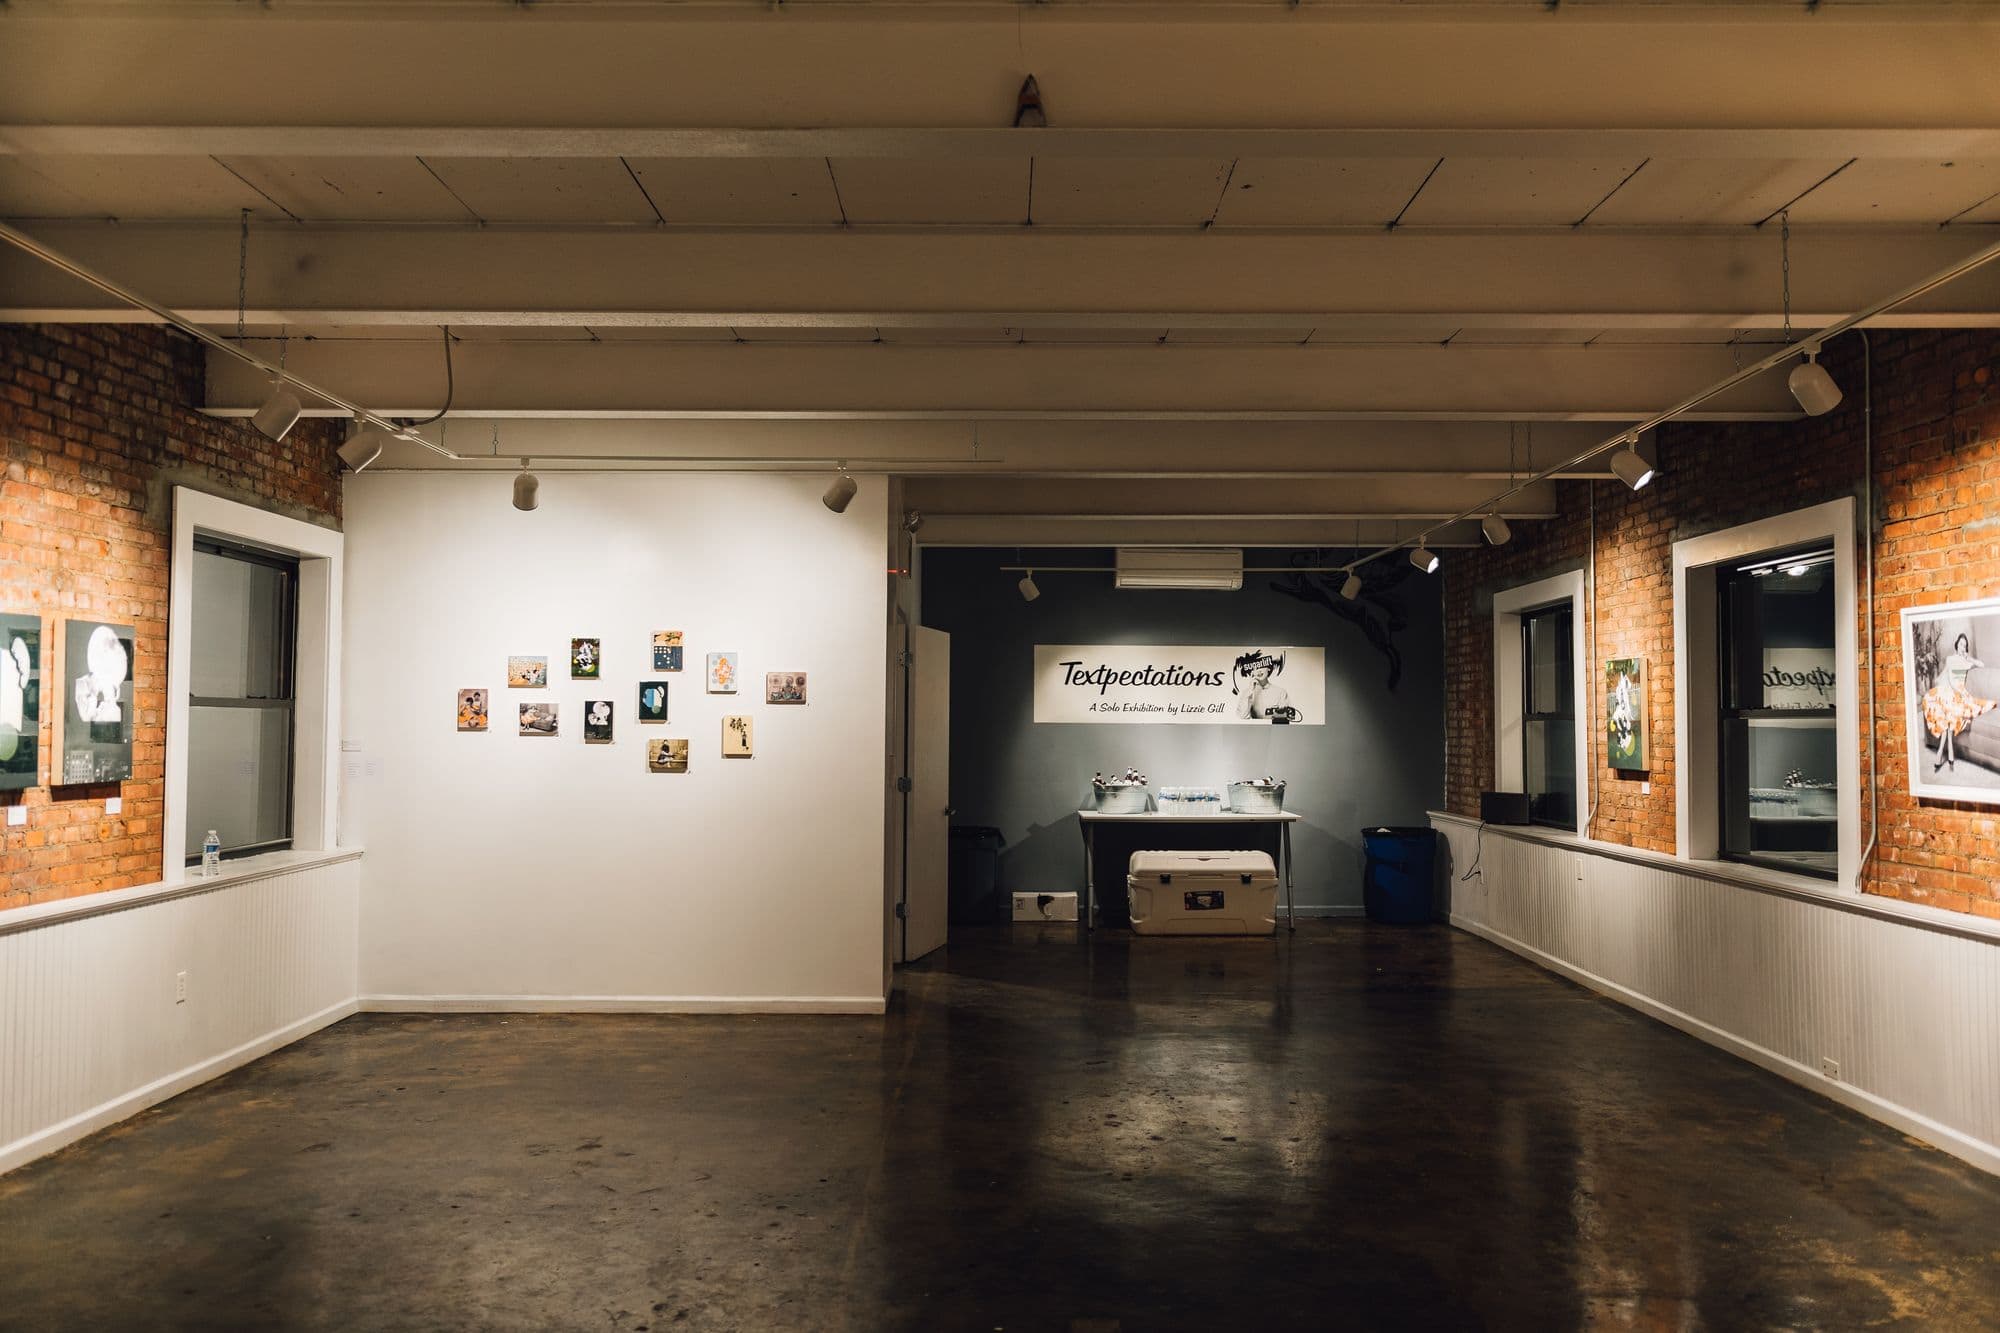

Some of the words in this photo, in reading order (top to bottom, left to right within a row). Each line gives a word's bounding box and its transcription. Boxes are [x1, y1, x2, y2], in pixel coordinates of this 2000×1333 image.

[1059, 661, 1226, 695] Textpectations
[1089, 703, 1097, 712] A
[1099, 702, 1120, 713] Solo
[1122, 702, 1164, 713] Exhibition
[1167, 702, 1179, 715] by
[1181, 703, 1205, 713] Lizzie
[1207, 702, 1226, 714] Gill
